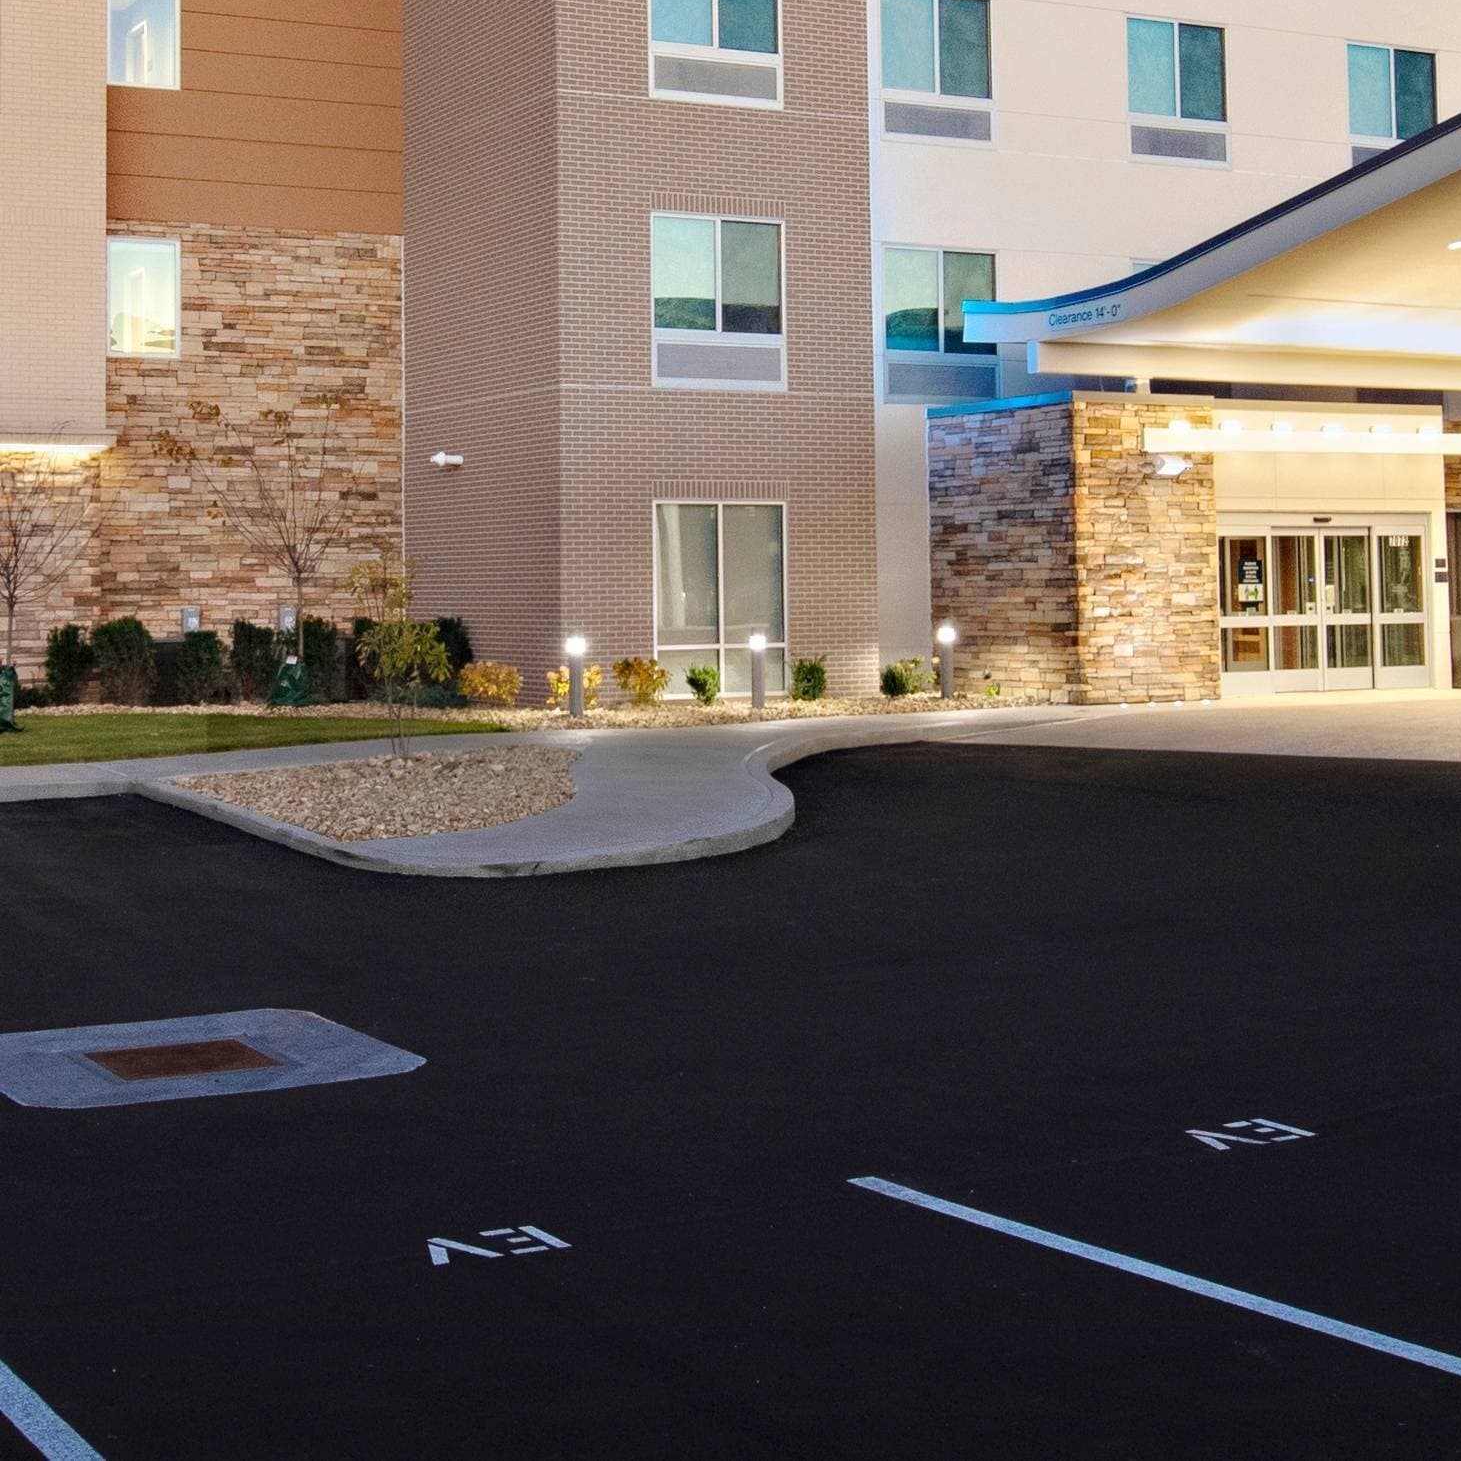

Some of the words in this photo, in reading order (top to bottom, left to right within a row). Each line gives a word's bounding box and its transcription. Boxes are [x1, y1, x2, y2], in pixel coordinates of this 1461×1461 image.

[1048, 311, 1093, 327] Clearance
[1184, 1118, 1317, 1151] EV
[426, 1225, 572, 1266] EV
